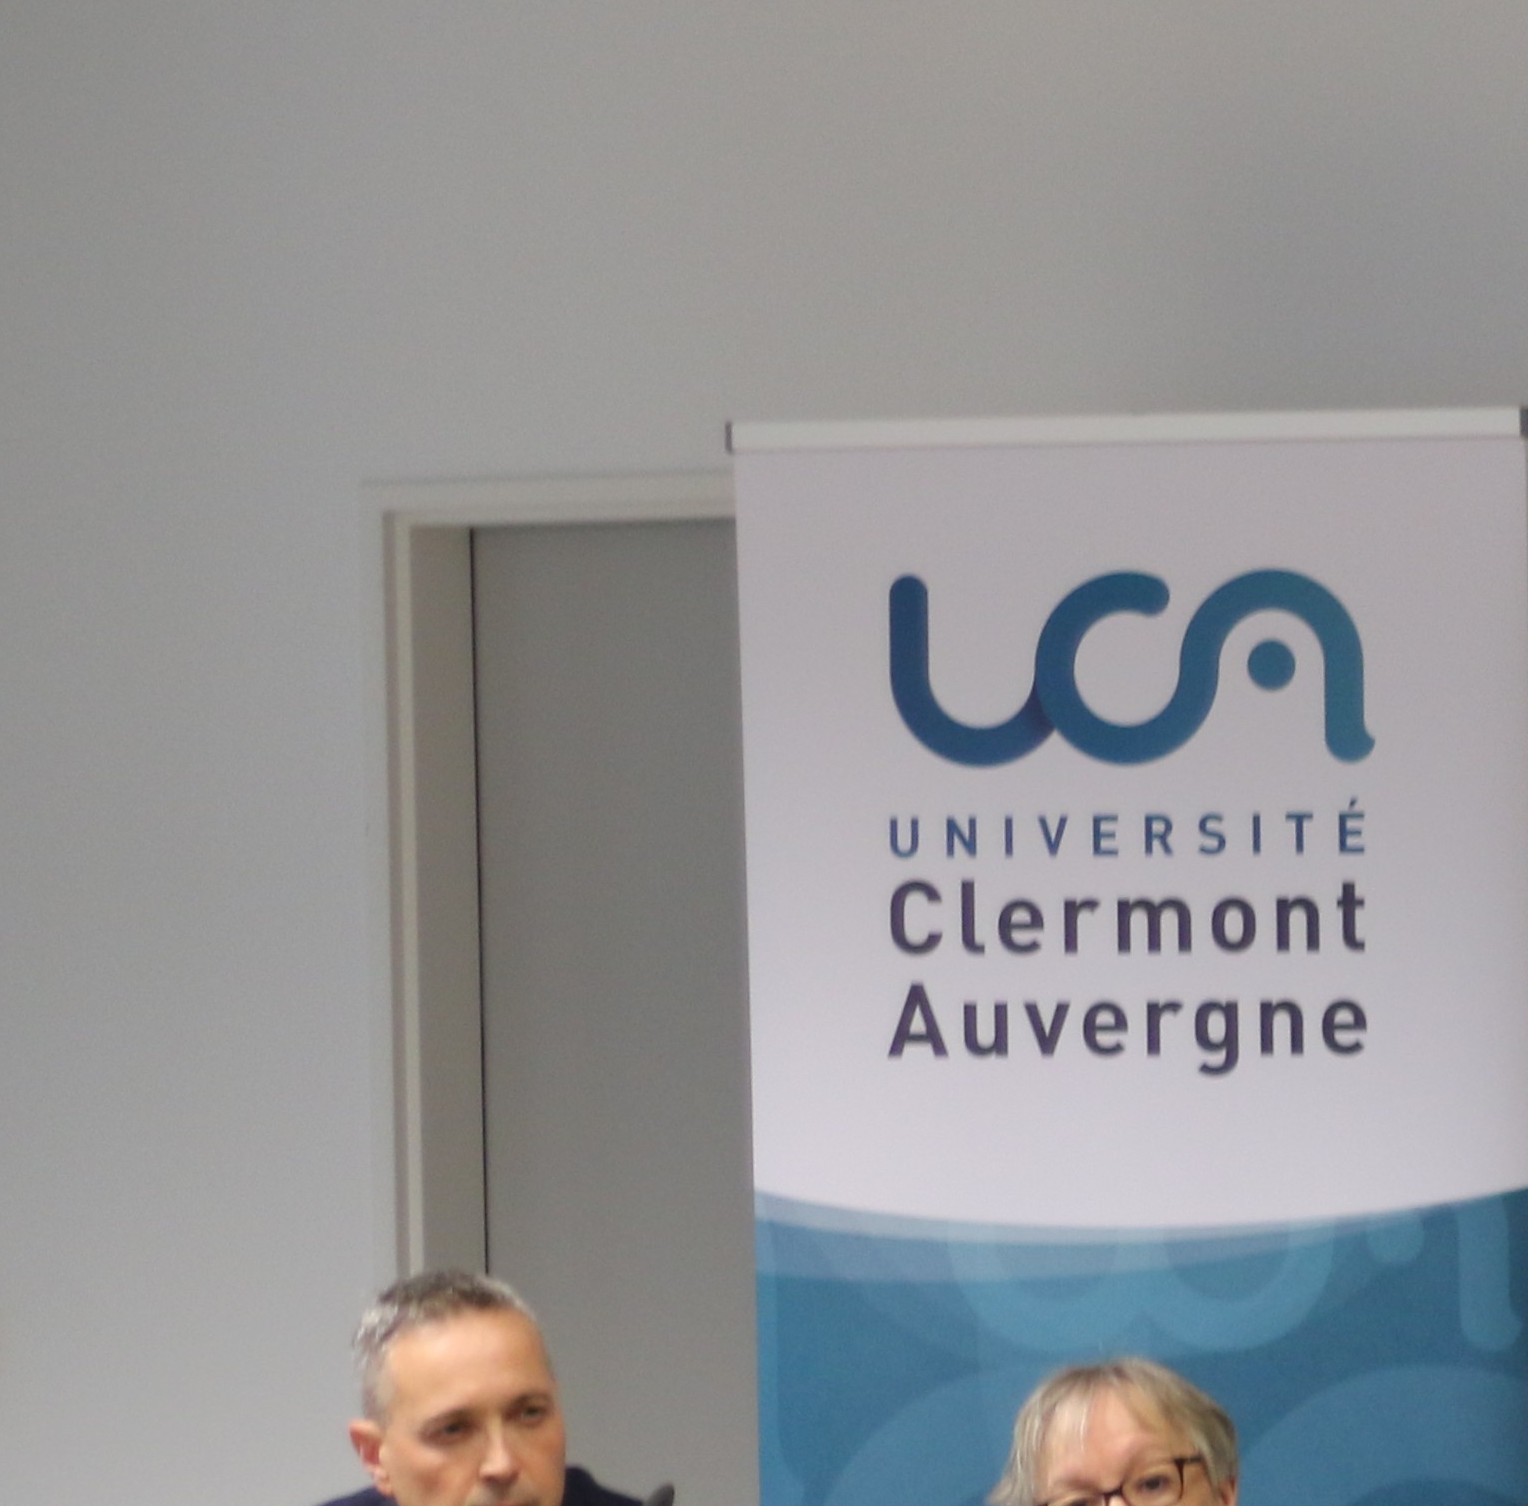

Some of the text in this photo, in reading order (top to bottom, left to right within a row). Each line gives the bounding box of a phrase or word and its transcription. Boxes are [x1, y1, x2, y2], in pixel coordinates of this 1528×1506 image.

[889, 568, 1375, 768] UCA
[890, 798, 1365, 858] UNIVERSITÉ
[890, 879, 1365, 955] Clermont
[888, 982, 1367, 1077] Auvergne
